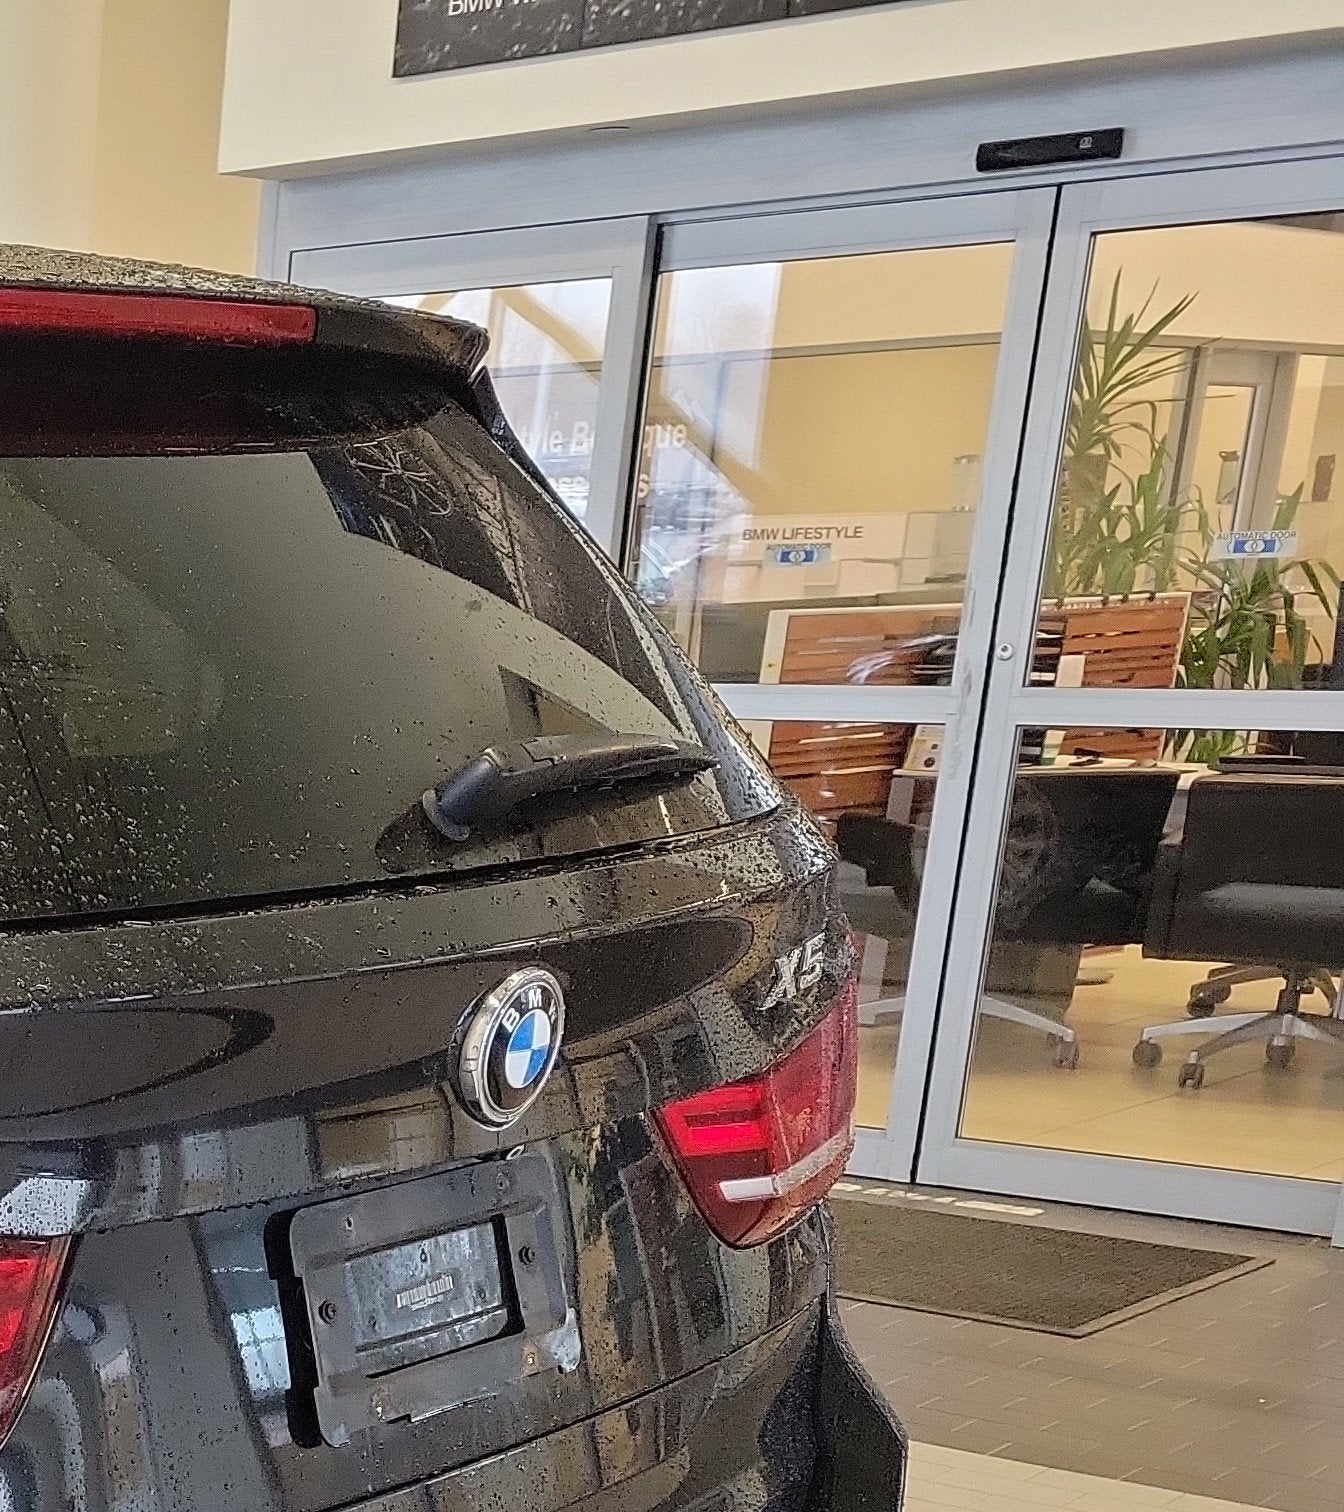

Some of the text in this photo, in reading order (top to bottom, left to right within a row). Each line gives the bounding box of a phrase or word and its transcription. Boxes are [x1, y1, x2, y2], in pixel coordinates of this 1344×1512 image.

[742, 526, 864, 541] BMW LIFESTYLE
[1217, 530, 1297, 541] AUTOMATIC DOOR
[756, 932, 827, 1011] X5
[501, 987, 558, 1033] BMW
